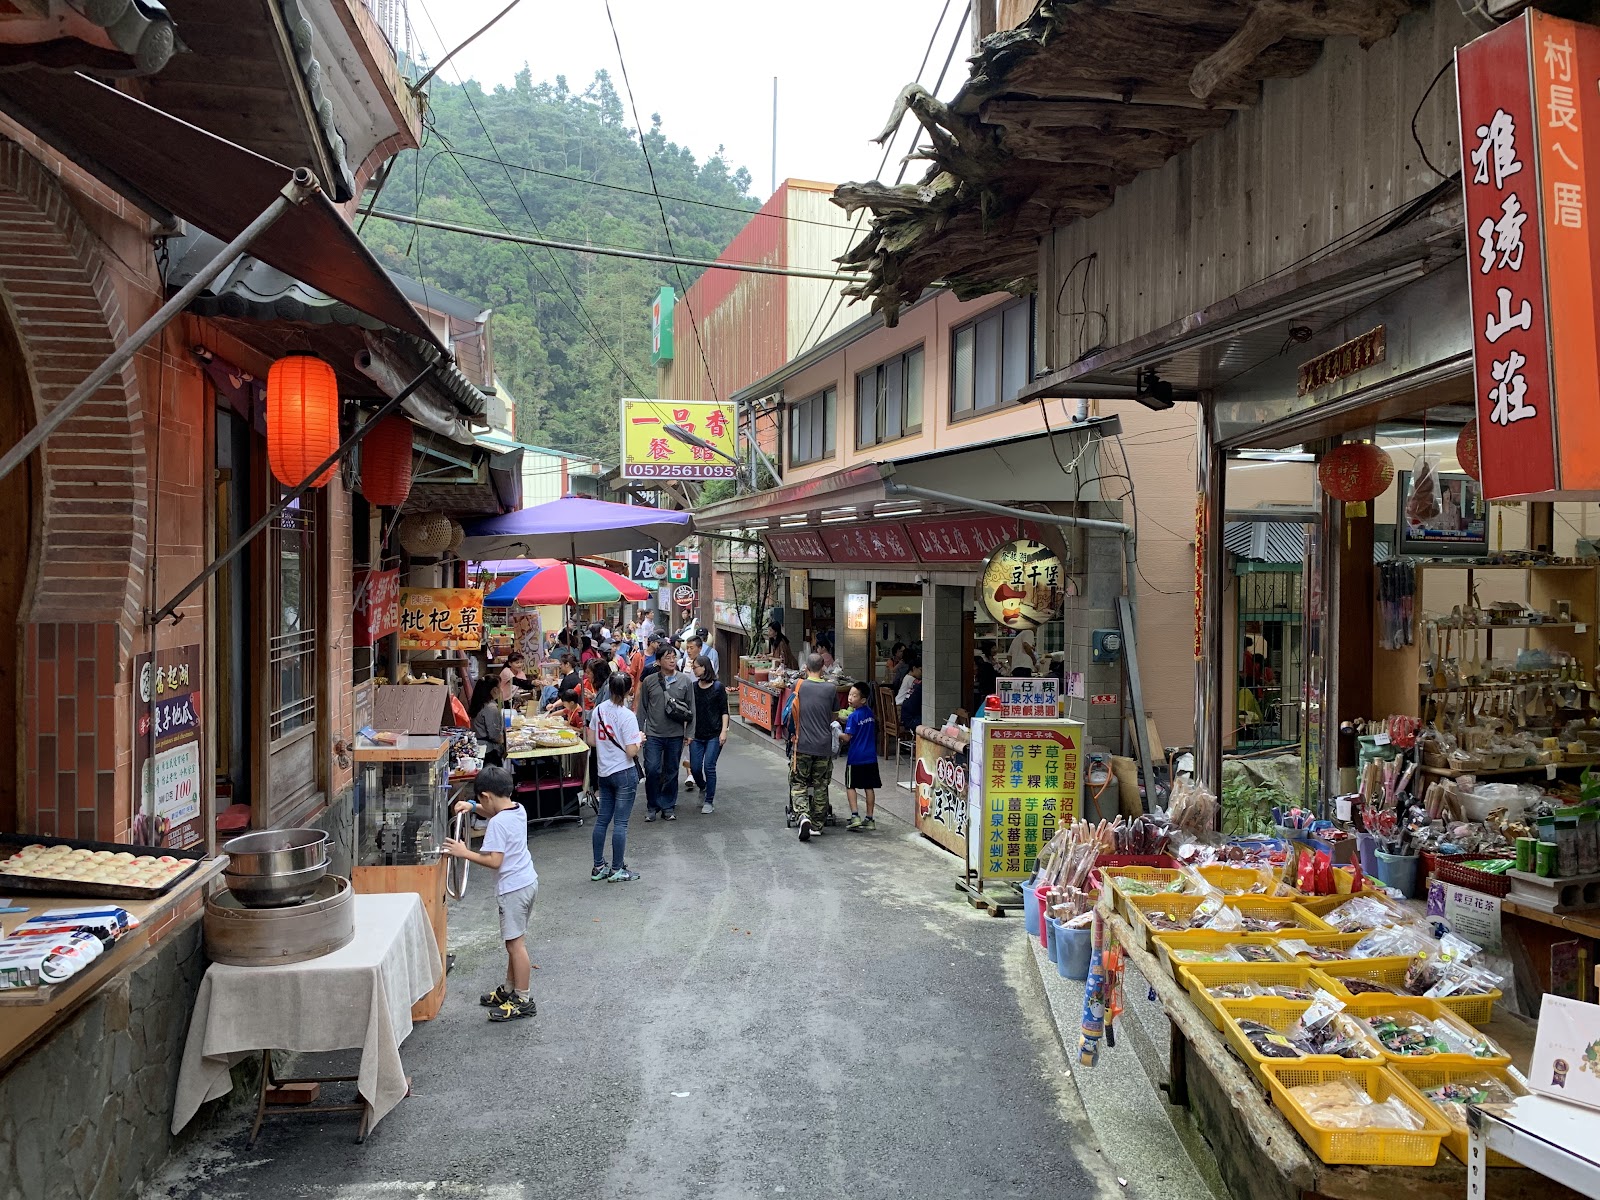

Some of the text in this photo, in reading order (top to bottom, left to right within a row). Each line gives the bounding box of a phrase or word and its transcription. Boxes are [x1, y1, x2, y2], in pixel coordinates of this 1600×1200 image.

[632, 409, 728, 437] 一品香
[647, 438, 716, 460] 餐館
[629, 465, 734, 476] (05)2561095
[919, 524, 1028, 555] 山泉豆腐 放山土
[1011, 565, 1059, 587] 豆干堡
[400, 607, 480, 633] 枇杷菓
[1000, 681, 1055, 692] 草仔粿
[1000, 693, 1056, 704] 山泉水剉冰
[1000, 705, 1056, 716] 招牌鹹湯圓
[992, 745, 1006, 788] 薑母茶
[1010, 745, 1024, 788] 冷凍芋
[1027, 745, 1042, 788] 芋粿
[1045, 745, 1059, 788] 草仔粿
[1063, 753, 1077, 789] 自製自銷
[174, 778, 192, 801] 100
[1042, 798, 1057, 847] 綜合圓
